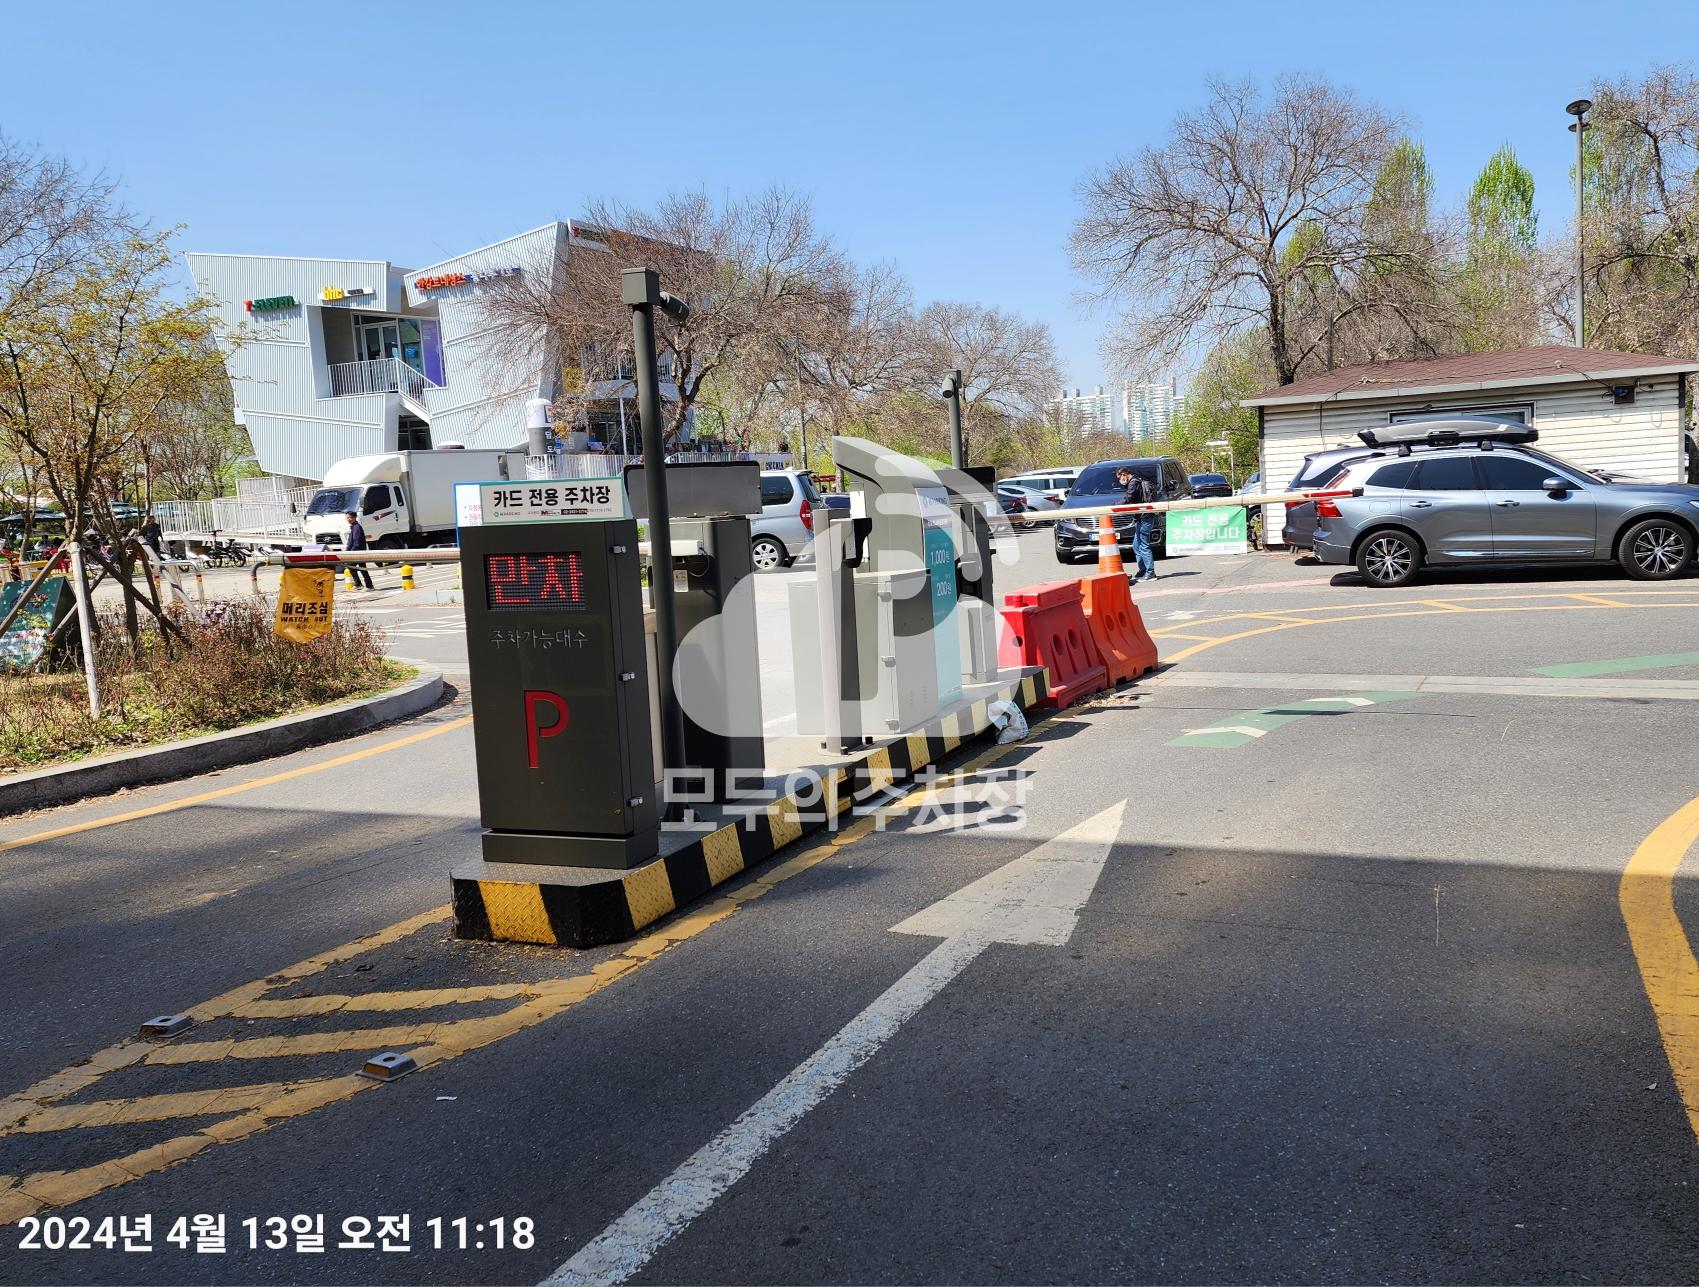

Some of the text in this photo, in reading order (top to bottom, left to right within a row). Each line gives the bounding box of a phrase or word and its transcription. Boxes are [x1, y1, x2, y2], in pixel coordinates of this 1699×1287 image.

[494, 486, 611, 507] 카드 전용 주차장
[1181, 514, 1204, 527] 카드
[1172, 526, 1241, 540] 주차장입니다
[488, 554, 583, 604] 만차
[282, 602, 328, 615] 머리조심
[491, 629, 588, 650] 주차가능대수
[525, 690, 570, 769] P
